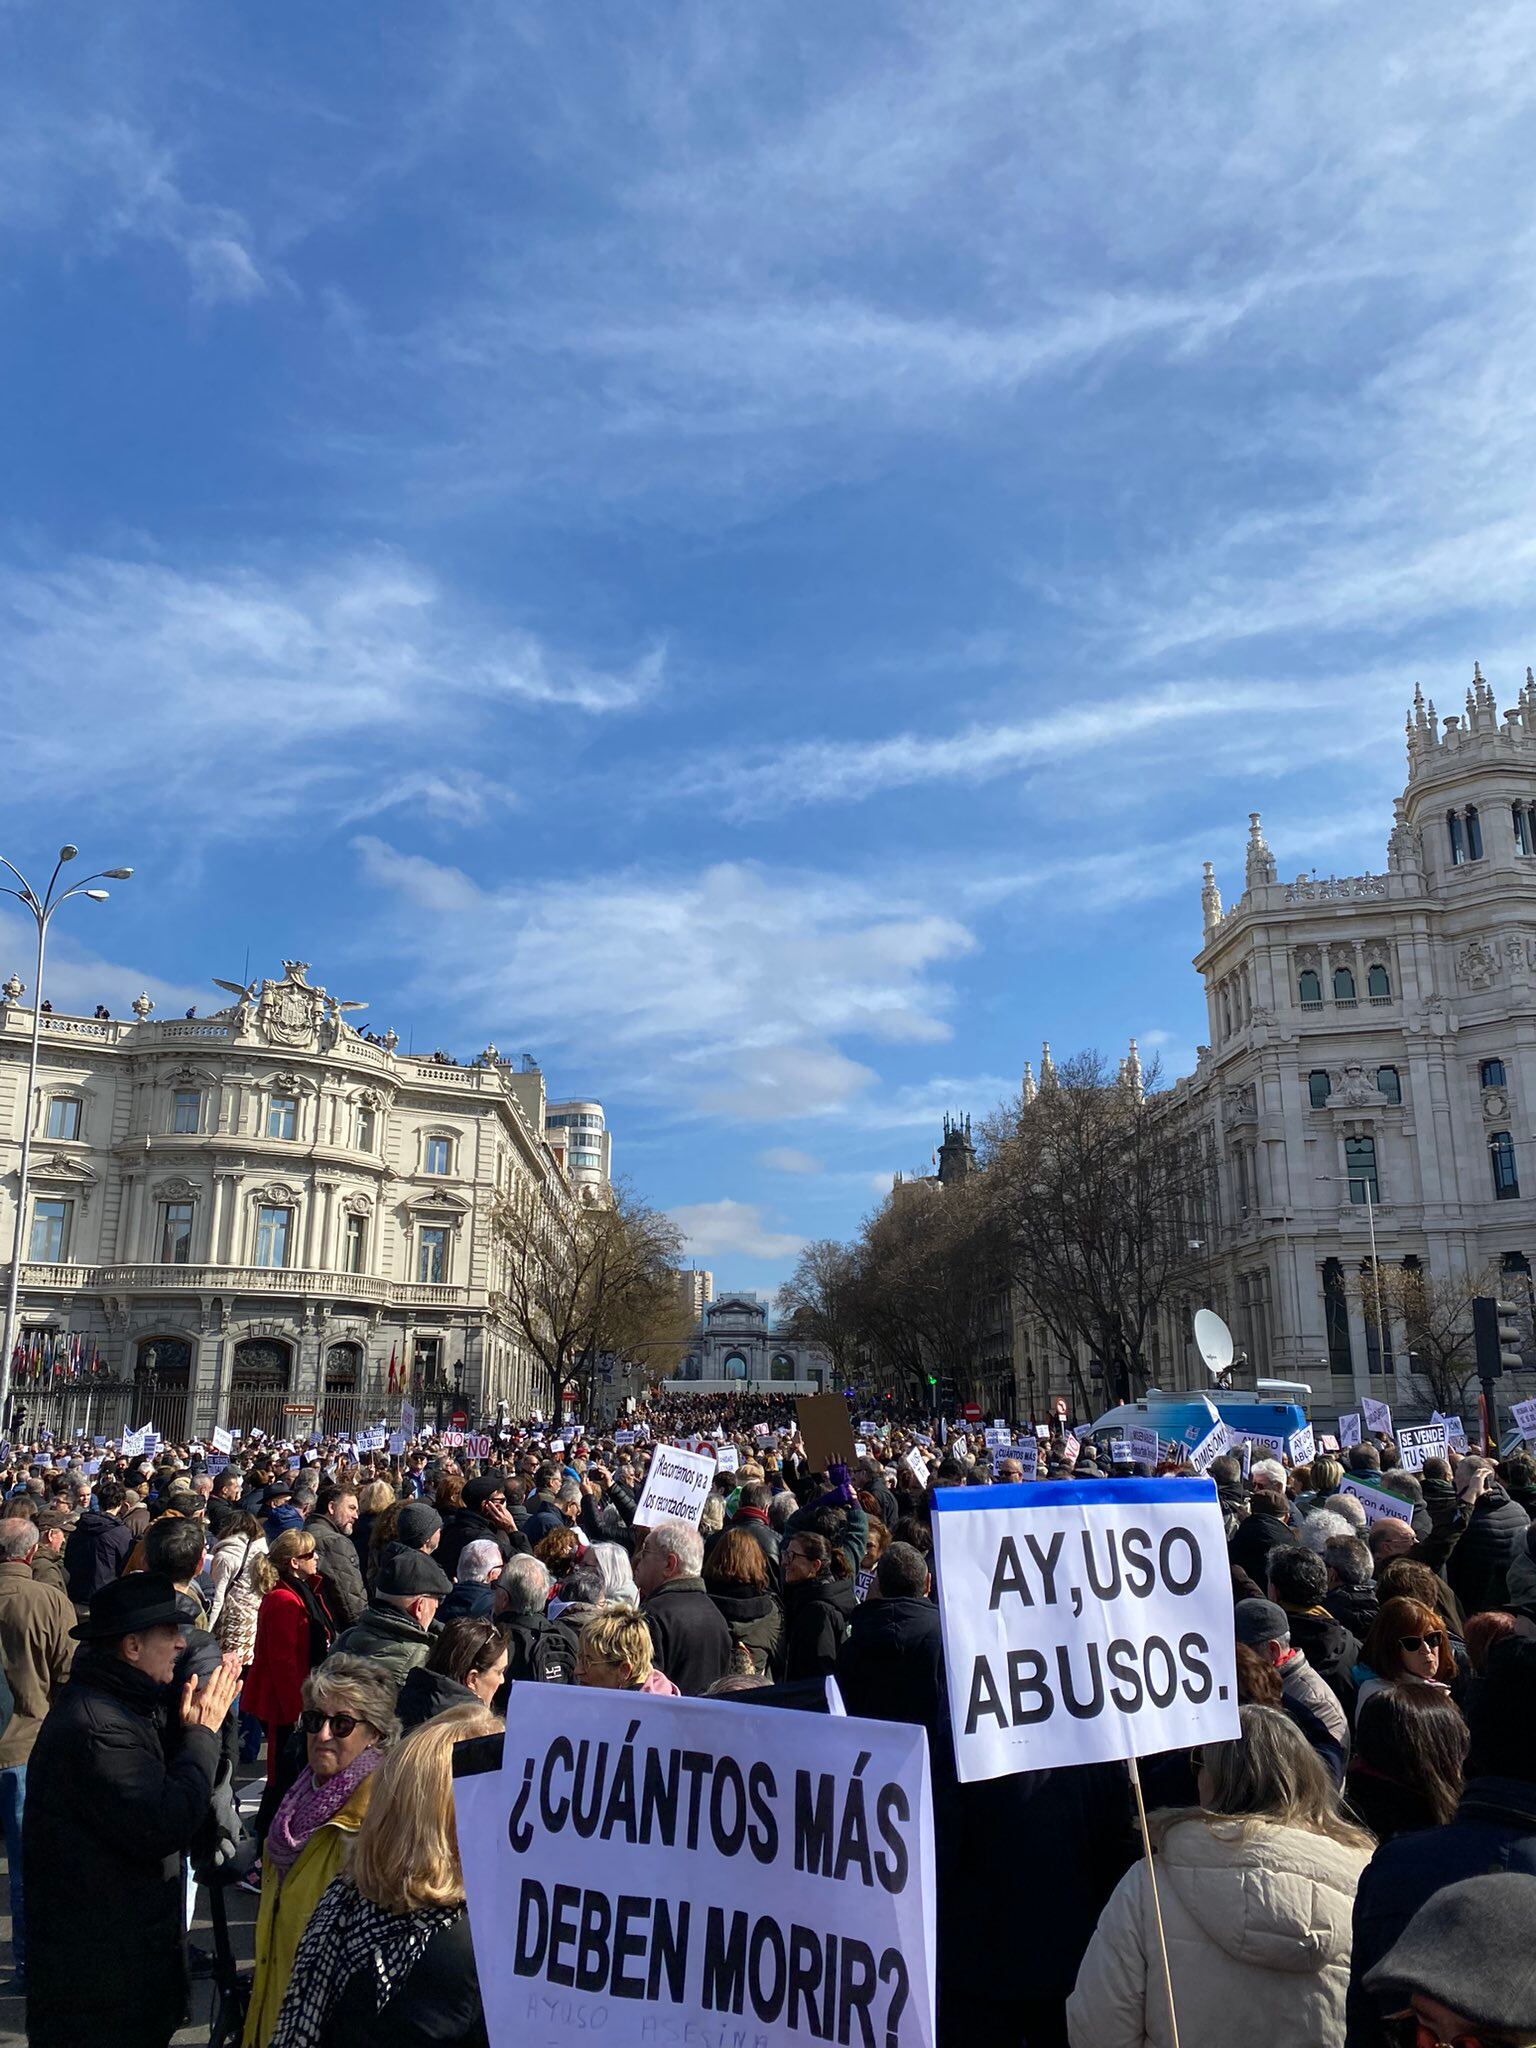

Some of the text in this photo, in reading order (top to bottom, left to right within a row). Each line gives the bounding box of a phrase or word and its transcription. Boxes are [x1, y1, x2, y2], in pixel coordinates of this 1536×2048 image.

[443, 1432, 464, 1447] NO
[467, 1437, 489, 1457] NO
[1064, 1436, 1079, 1458] NO
[1401, 1428, 1445, 1447] SE VENDE
[1024, 1450, 1037, 1462] MÁS
[1404, 1449, 1417, 1468] TU
[653, 1453, 709, 1492] ¡Recortemos ya a
[642, 1486, 702, 1521] los recortadores!
[1379, 1503, 1409, 1521] Ayuso
[989, 1527, 1202, 1618] AY,USO
[964, 1632, 1228, 1735] ABUSOS.
[508, 1719, 910, 1895] ¿CUÁNTOS MÁS
[512, 1877, 910, 2048] DEBEN MORIR?
[526, 1992, 609, 2030] AYUSO
